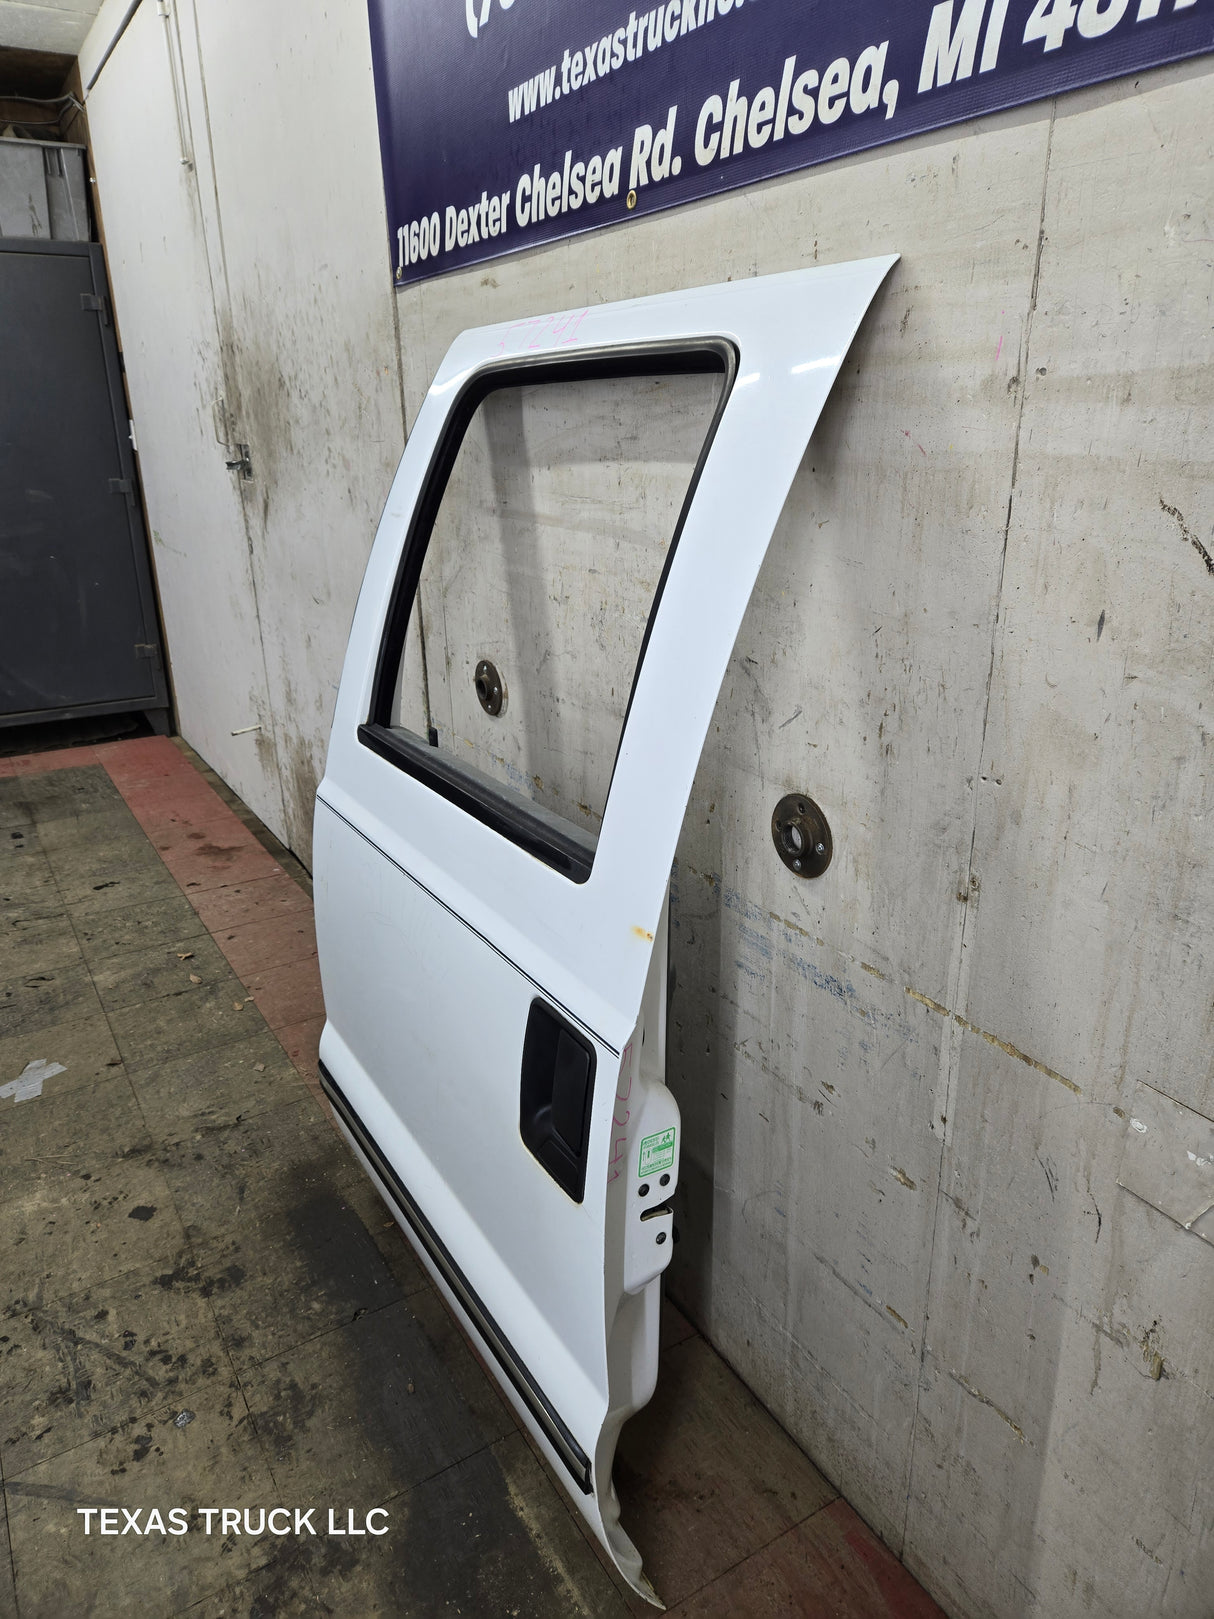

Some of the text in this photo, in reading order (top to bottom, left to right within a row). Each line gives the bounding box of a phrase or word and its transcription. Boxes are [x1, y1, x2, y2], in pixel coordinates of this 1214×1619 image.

[397, 212, 440, 267] 11600
[445, 191, 510, 251] Dexter
[515, 146, 623, 227] Chelsea
[629, 105, 682, 190] Rd.
[695, 41, 899, 166] Chelsea,
[918, 0, 1008, 94] MI
